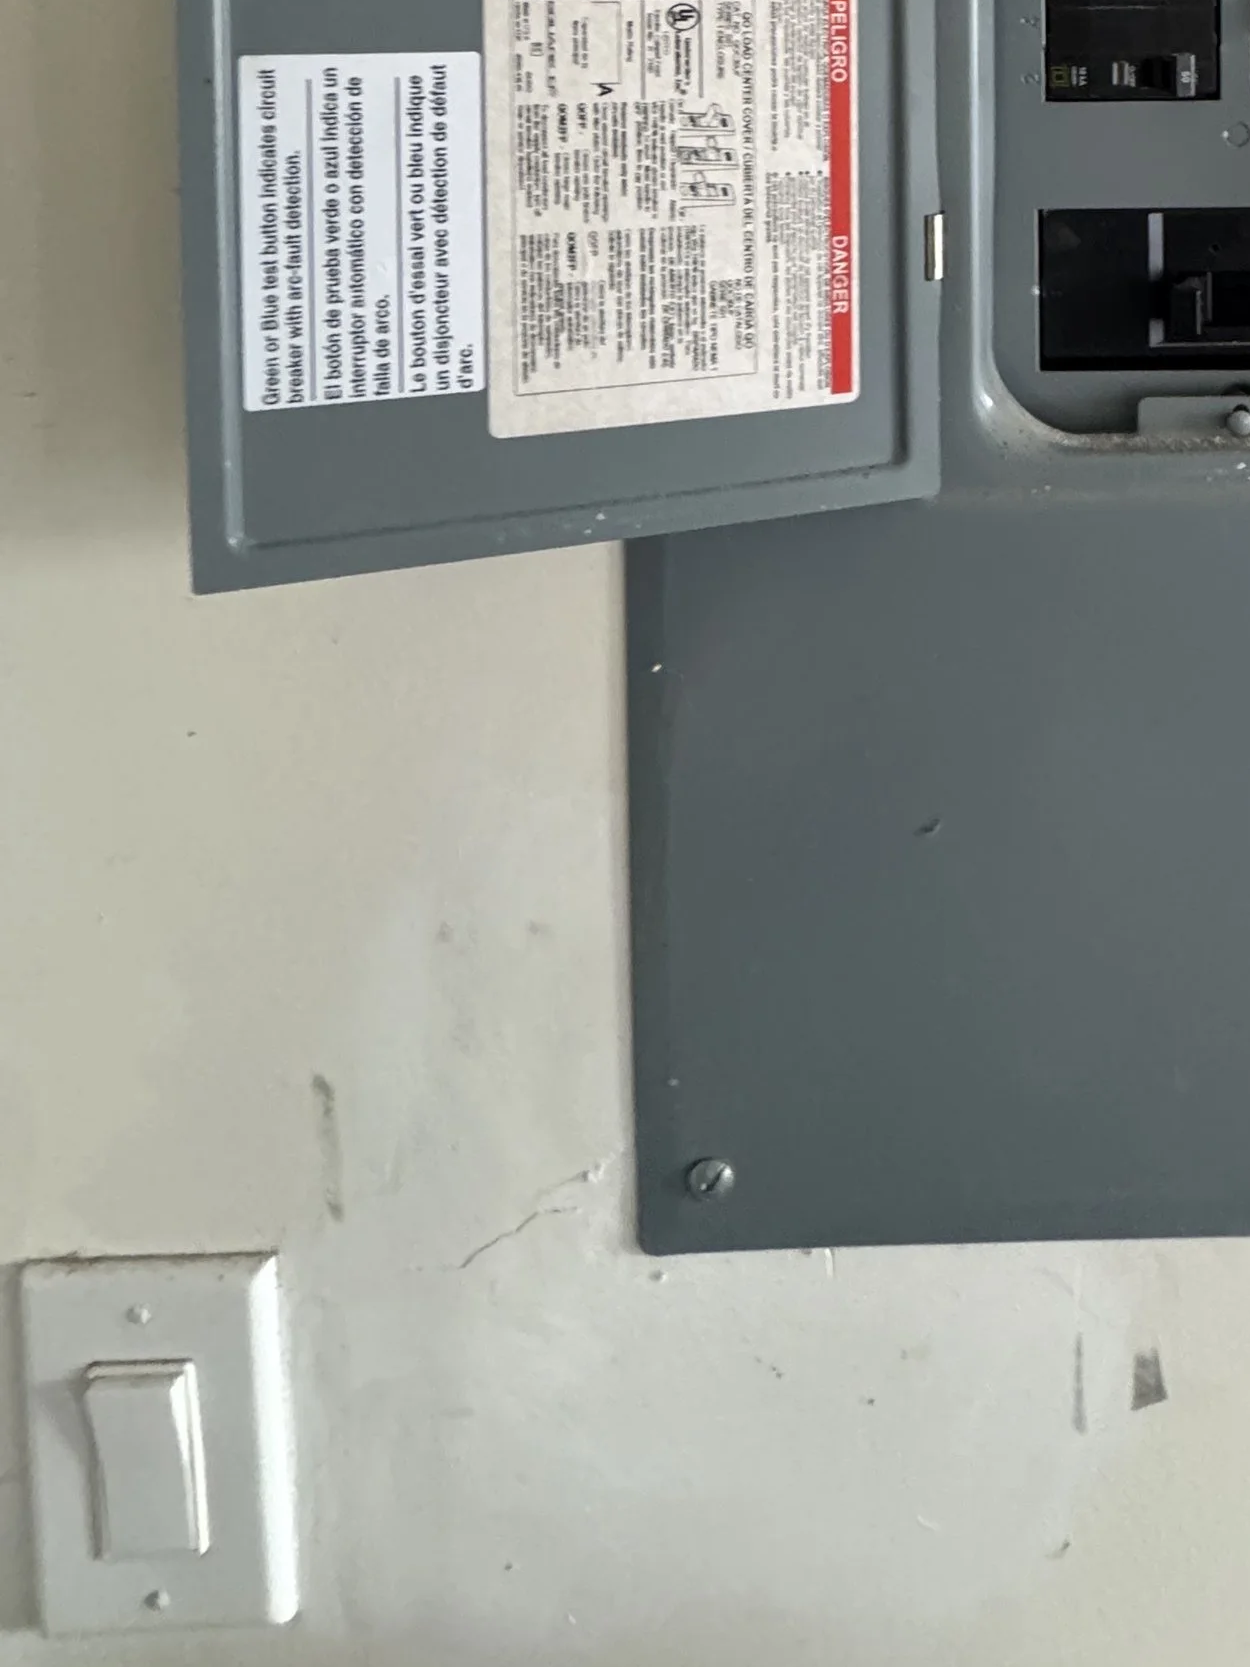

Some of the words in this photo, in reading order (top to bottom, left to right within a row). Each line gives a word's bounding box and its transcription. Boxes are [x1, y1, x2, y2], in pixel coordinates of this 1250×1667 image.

[743, 31, 753, 59] LOAD
[830, 0, 848, 83] PELIGRO
[256, 69, 276, 119] circuit
[322, 68, 338, 87] un
[345, 77, 362, 97] de
[429, 65, 446, 116] défaut
[743, 63, 753, 104] CENTER
[320, 93, 338, 141] indica
[405, 76, 427, 137] indique
[743, 107, 753, 144] COVER
[346, 103, 363, 179] detección
[430, 122, 446, 142] de
[257, 126, 277, 198] indicates
[320, 146, 338, 179] azul
[406, 143, 423, 178] bleu
[743, 153, 753, 205] CUBIERTA
[283, 151, 301, 230] detection.
[325, 184, 339, 194] o
[349, 185, 365, 214] con
[410, 184, 424, 204] ou
[430, 147, 448, 224] détection
[259, 203, 278, 255] button
[321, 199, 339, 244] verde
[408, 210, 424, 241] vert
[743, 207, 753, 228] DEL
[284, 235, 302, 301] arc-fault
[346, 219, 365, 308] automático
[434, 230, 448, 267] avec
[743, 230, 753, 273] CENTRO
[261, 260, 278, 290] test
[322, 249, 345, 304] prueba
[407, 247, 425, 304] d'essai
[743, 276, 753, 291] DE
[832, 235, 849, 314] DANGER
[260, 295, 279, 330] Blue
[284, 306, 303, 338] with
[323, 310, 341, 328] de
[375, 295, 390, 334] arco.
[433, 273, 454, 365] disjoncteur
[743, 293, 753, 330] CARGA
[264, 336, 279, 351] or
[322, 334, 341, 379] botón
[347, 314, 369, 397] interruptor
[372, 339, 390, 358] de
[408, 310, 426, 367] bouton
[260, 358, 280, 405] Green
[286, 345, 304, 403] breaker
[373, 363, 390, 395] falla
[409, 374, 426, 393] Le
[435, 371, 450, 391] un
[457, 344, 474, 388] d'arc.
[324, 385, 342, 399] El
